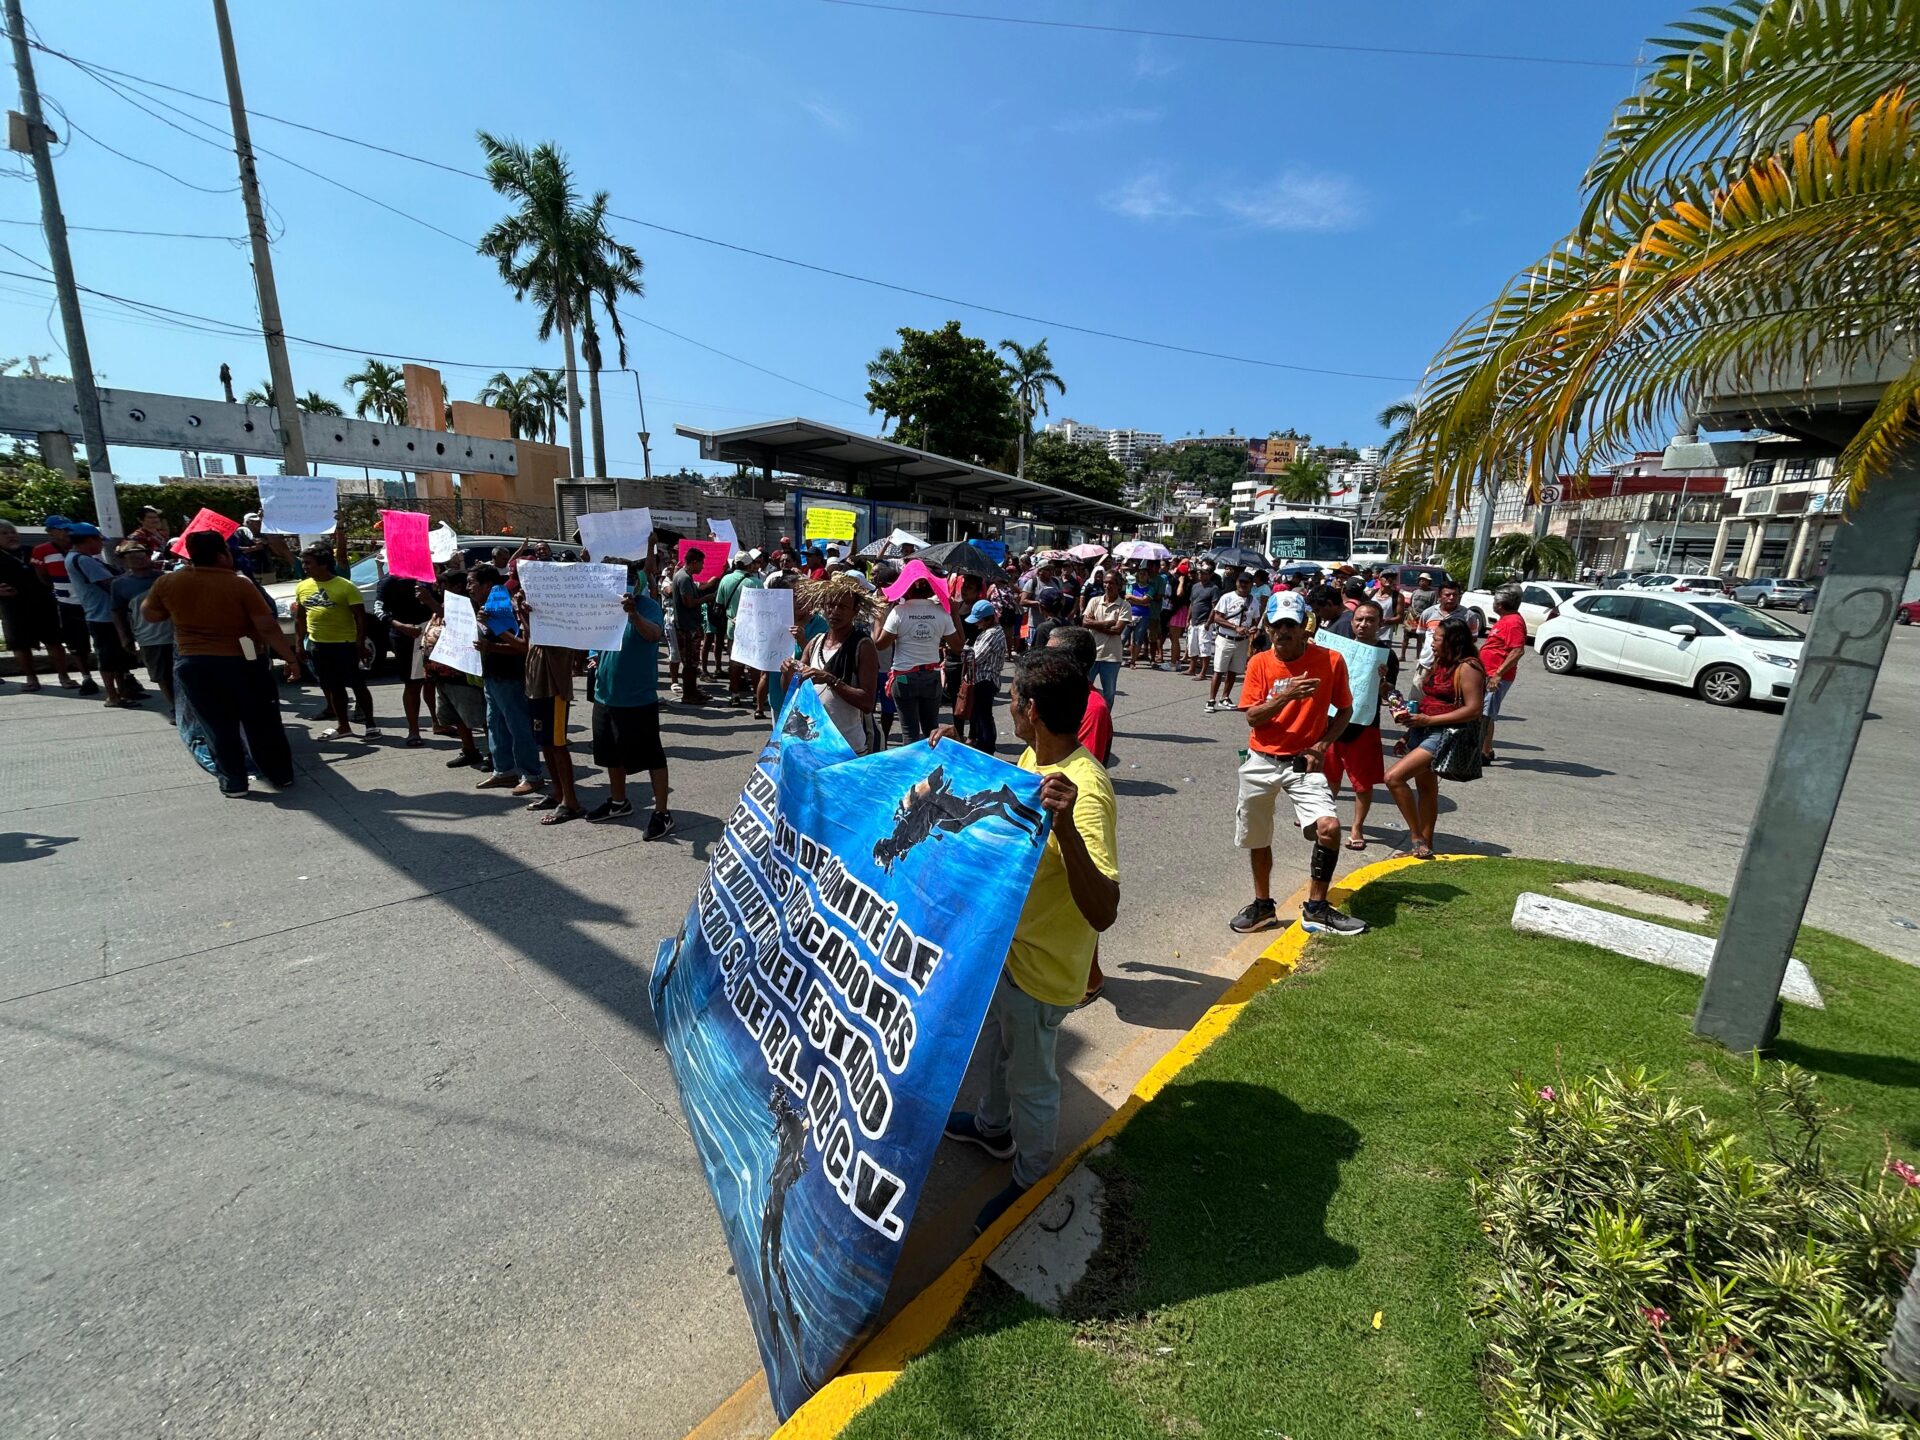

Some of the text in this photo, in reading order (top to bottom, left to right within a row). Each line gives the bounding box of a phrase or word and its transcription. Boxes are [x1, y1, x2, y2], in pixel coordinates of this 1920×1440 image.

[1276, 549, 1306, 559] COLOSIO
[799, 835, 830, 881] DE
[818, 858, 896, 953] COMITÉ
[883, 923, 941, 992] DE
[733, 976, 771, 1039] DE
[759, 940, 806, 1009] DEL
[799, 983, 890, 1134] ESTADO
[809, 1070, 840, 1146] DE
[824, 1122, 901, 1235] C.V.
